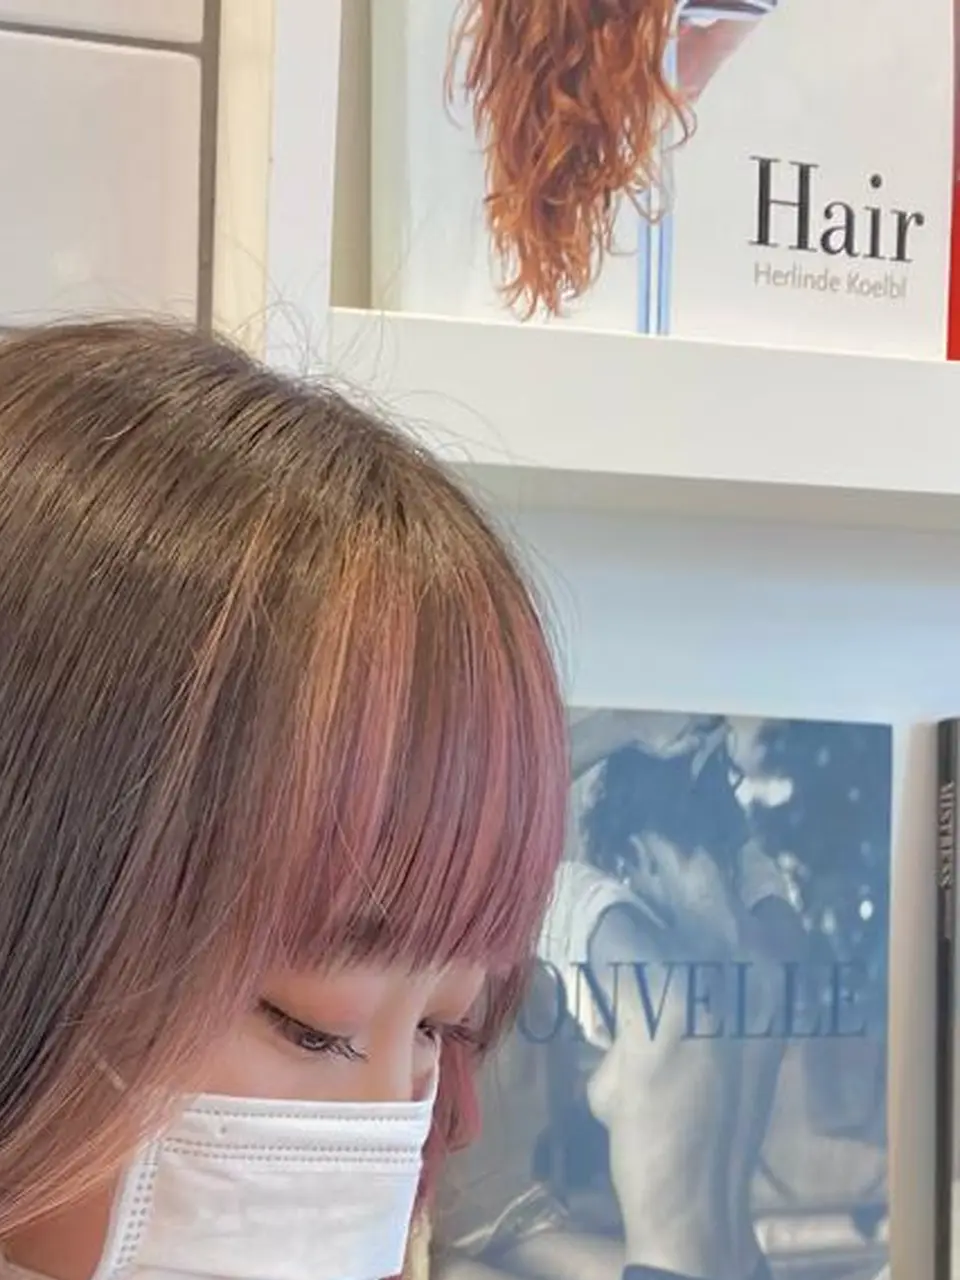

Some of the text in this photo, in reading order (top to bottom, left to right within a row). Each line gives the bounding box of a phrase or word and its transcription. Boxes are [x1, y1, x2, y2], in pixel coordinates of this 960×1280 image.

[747, 155, 925, 263] Hair
[753, 261, 908, 299] Herlinde Koelbl
